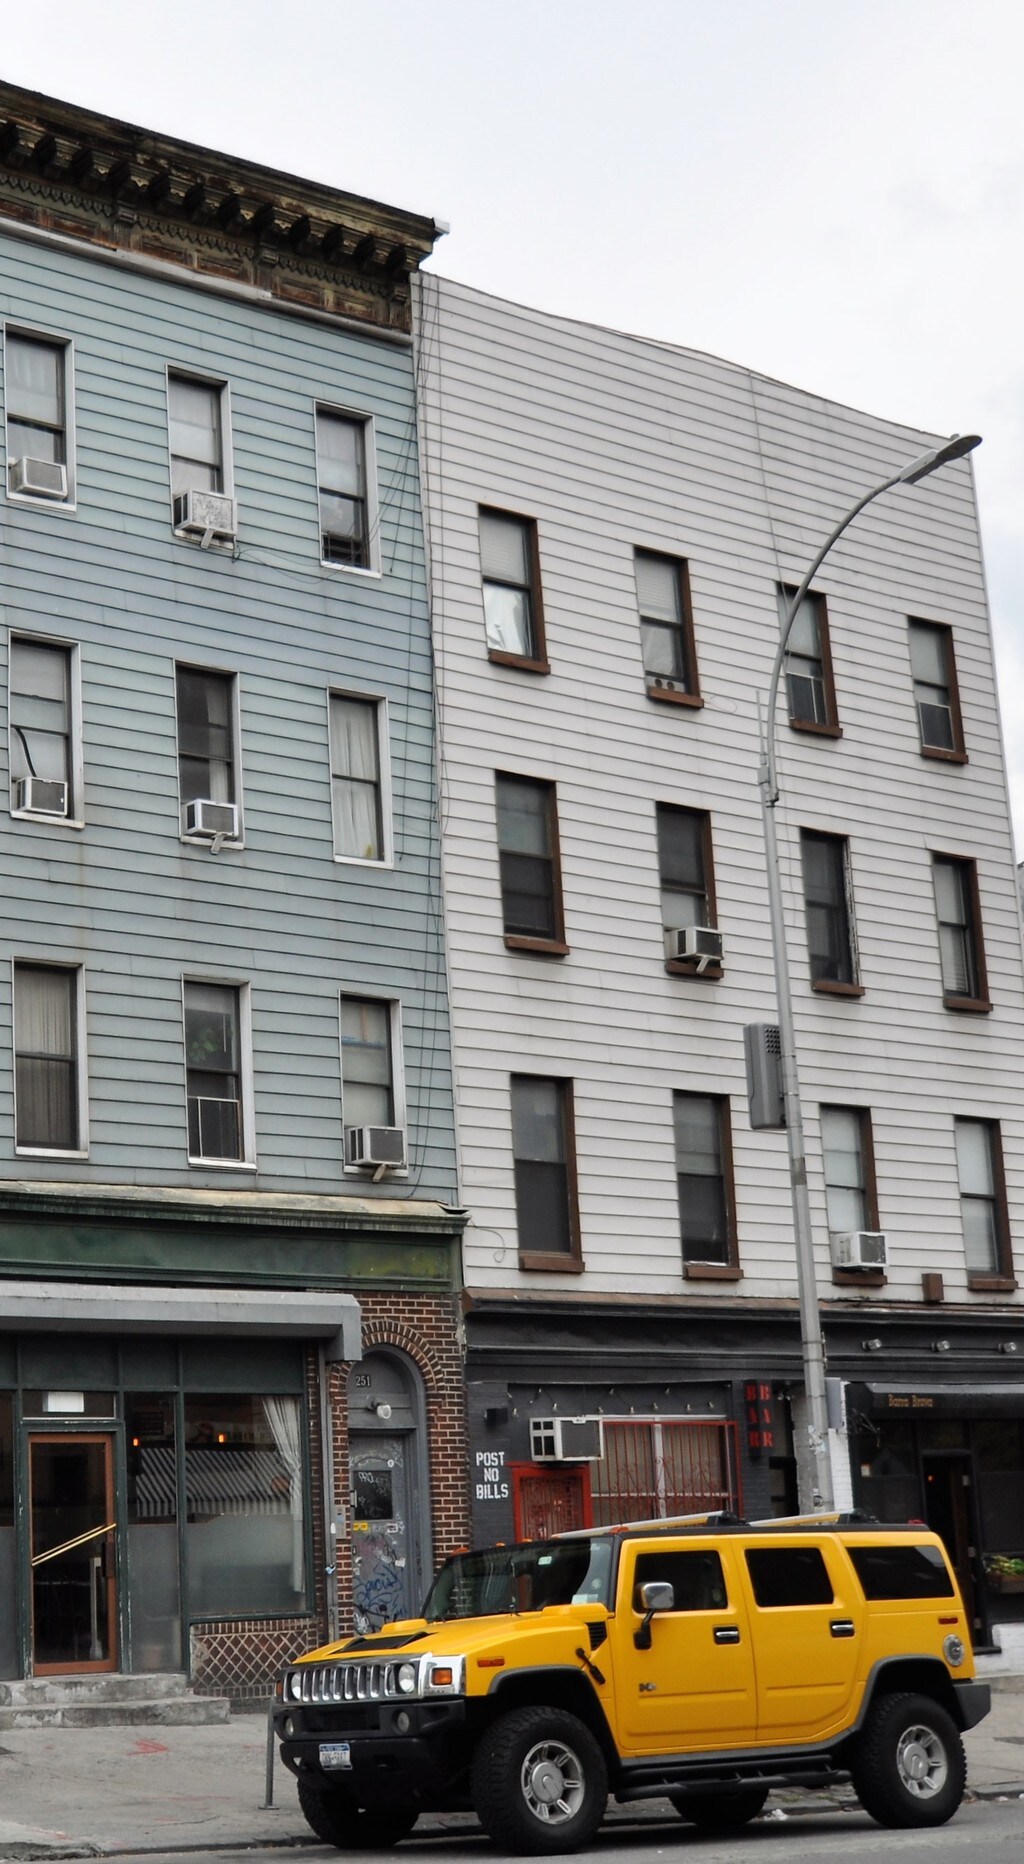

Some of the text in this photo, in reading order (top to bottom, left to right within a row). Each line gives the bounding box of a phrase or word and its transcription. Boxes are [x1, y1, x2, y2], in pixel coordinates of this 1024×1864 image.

[356, 1375, 371, 1387] 251
[745, 1384, 760, 1447] BAR
[760, 1384, 774, 1447] BAR
[476, 1451, 505, 1466] POST
[484, 1467, 499, 1482] NO
[476, 1483, 509, 1499] BILLS
